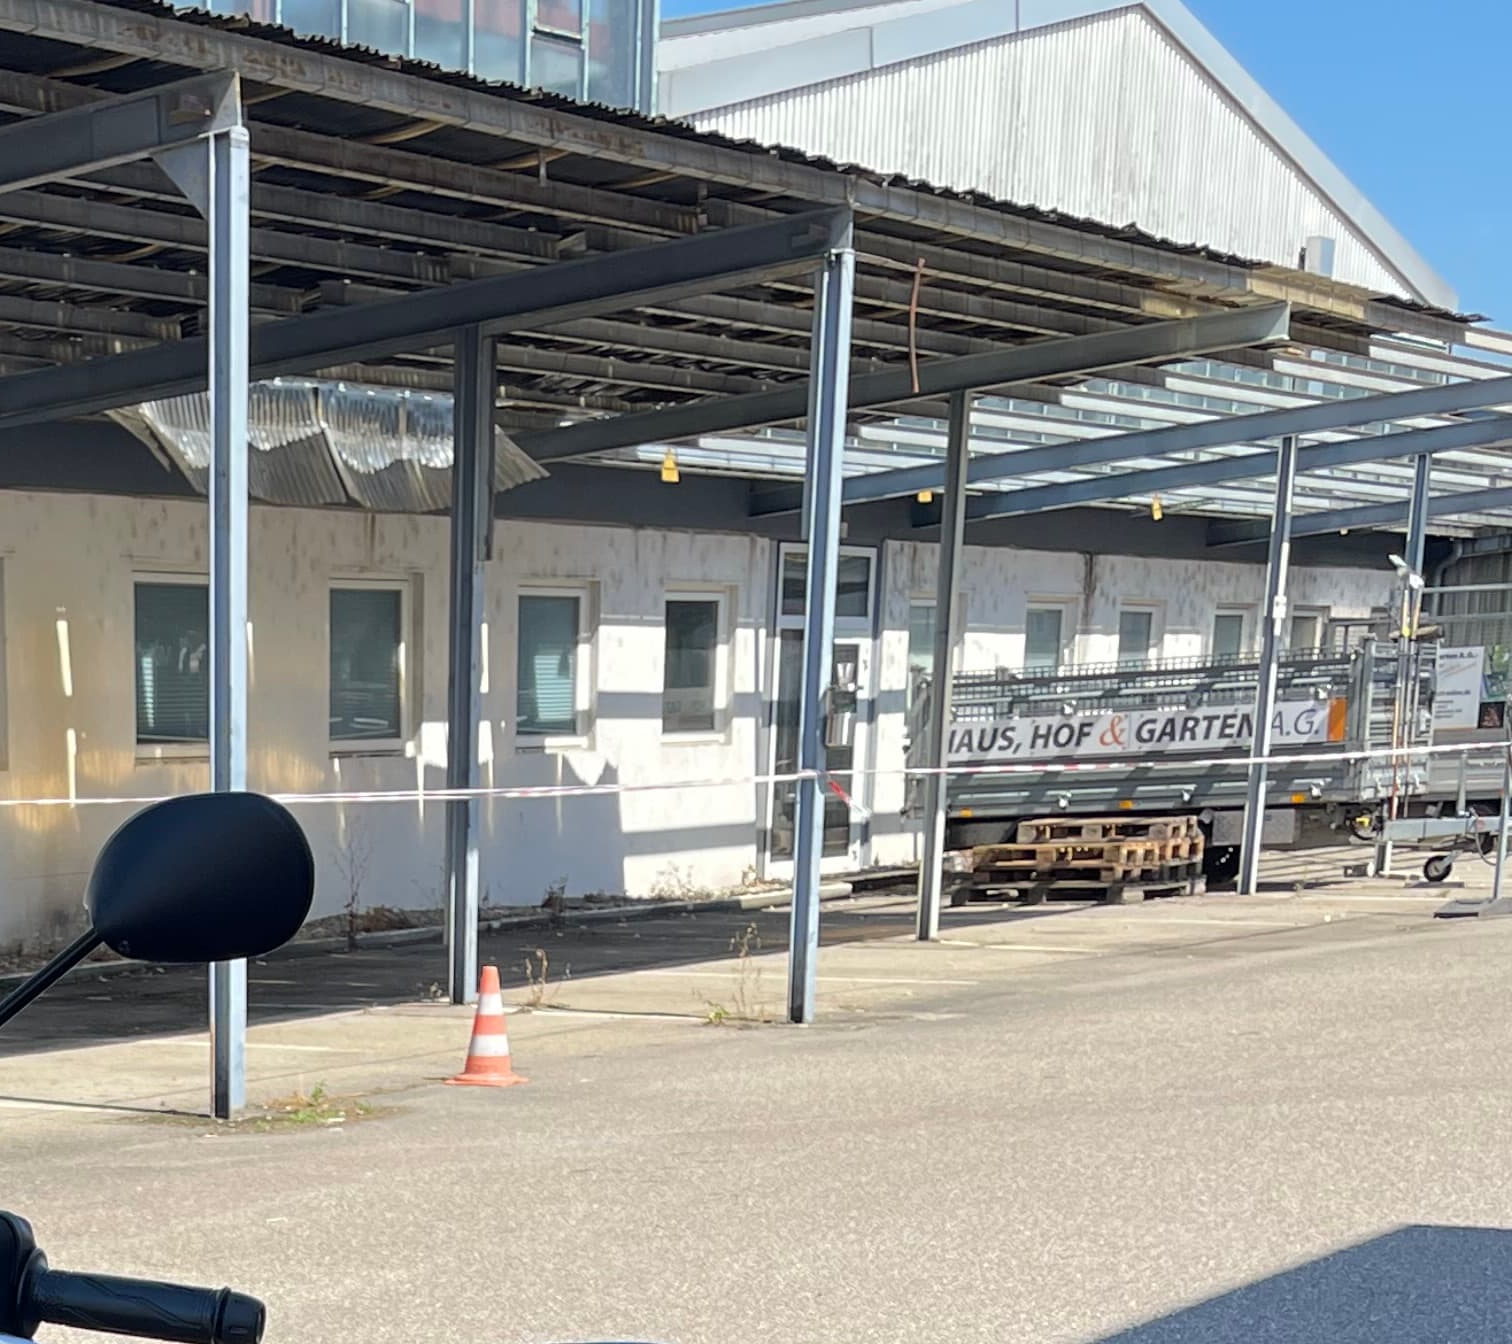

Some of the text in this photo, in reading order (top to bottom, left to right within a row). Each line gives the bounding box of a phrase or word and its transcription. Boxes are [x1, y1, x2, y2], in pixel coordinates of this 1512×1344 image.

[1029, 721, 1095, 750] HOF
[1099, 714, 1126, 747] &
[1271, 708, 1321, 737] A.G.
